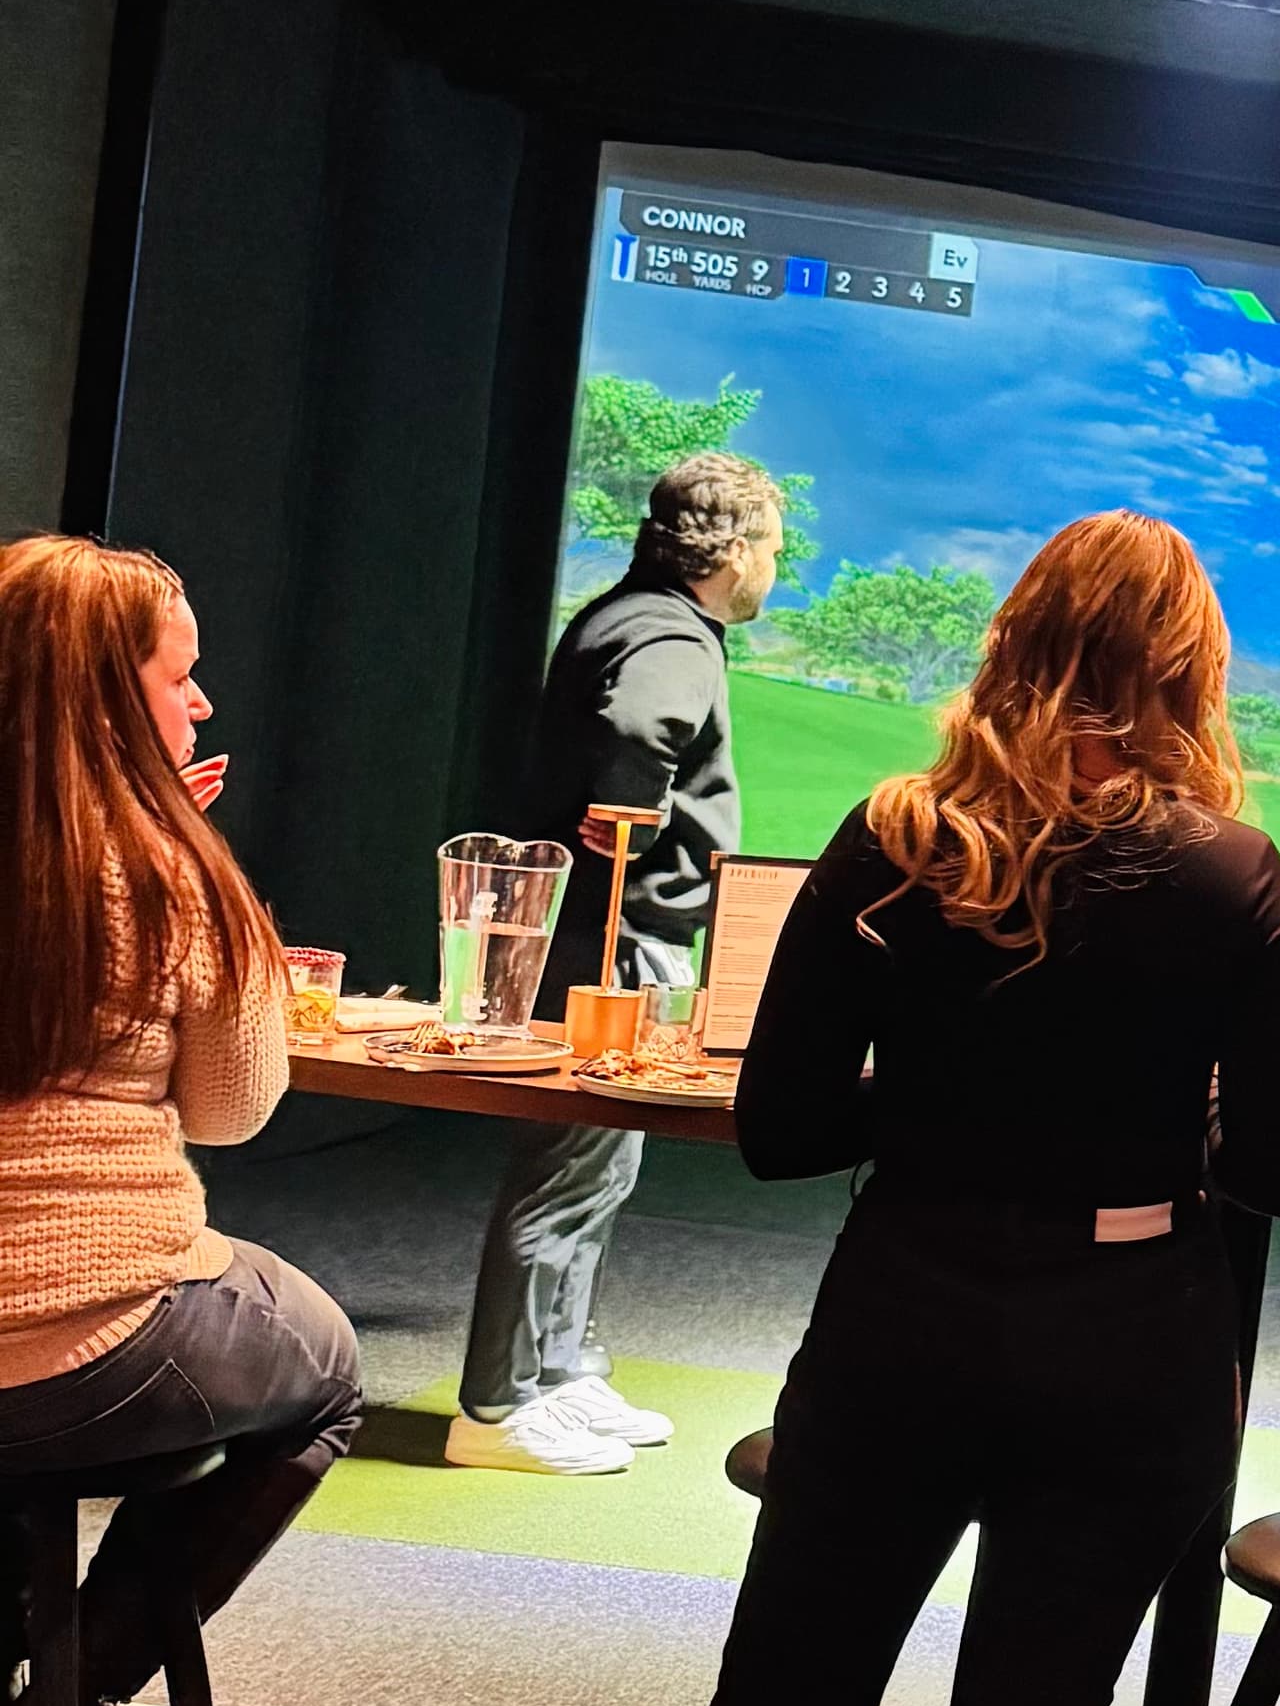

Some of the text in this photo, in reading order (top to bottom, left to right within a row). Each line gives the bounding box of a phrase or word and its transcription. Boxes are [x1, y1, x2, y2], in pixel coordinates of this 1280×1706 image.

[642, 205, 746, 239] CONNOR
[645, 244, 769, 281] 15th 505 9
[943, 249, 968, 269] Ev
[645, 270, 772, 297] HOLE YARDS HCP
[802, 267, 962, 308] 1 2 3 4 5
